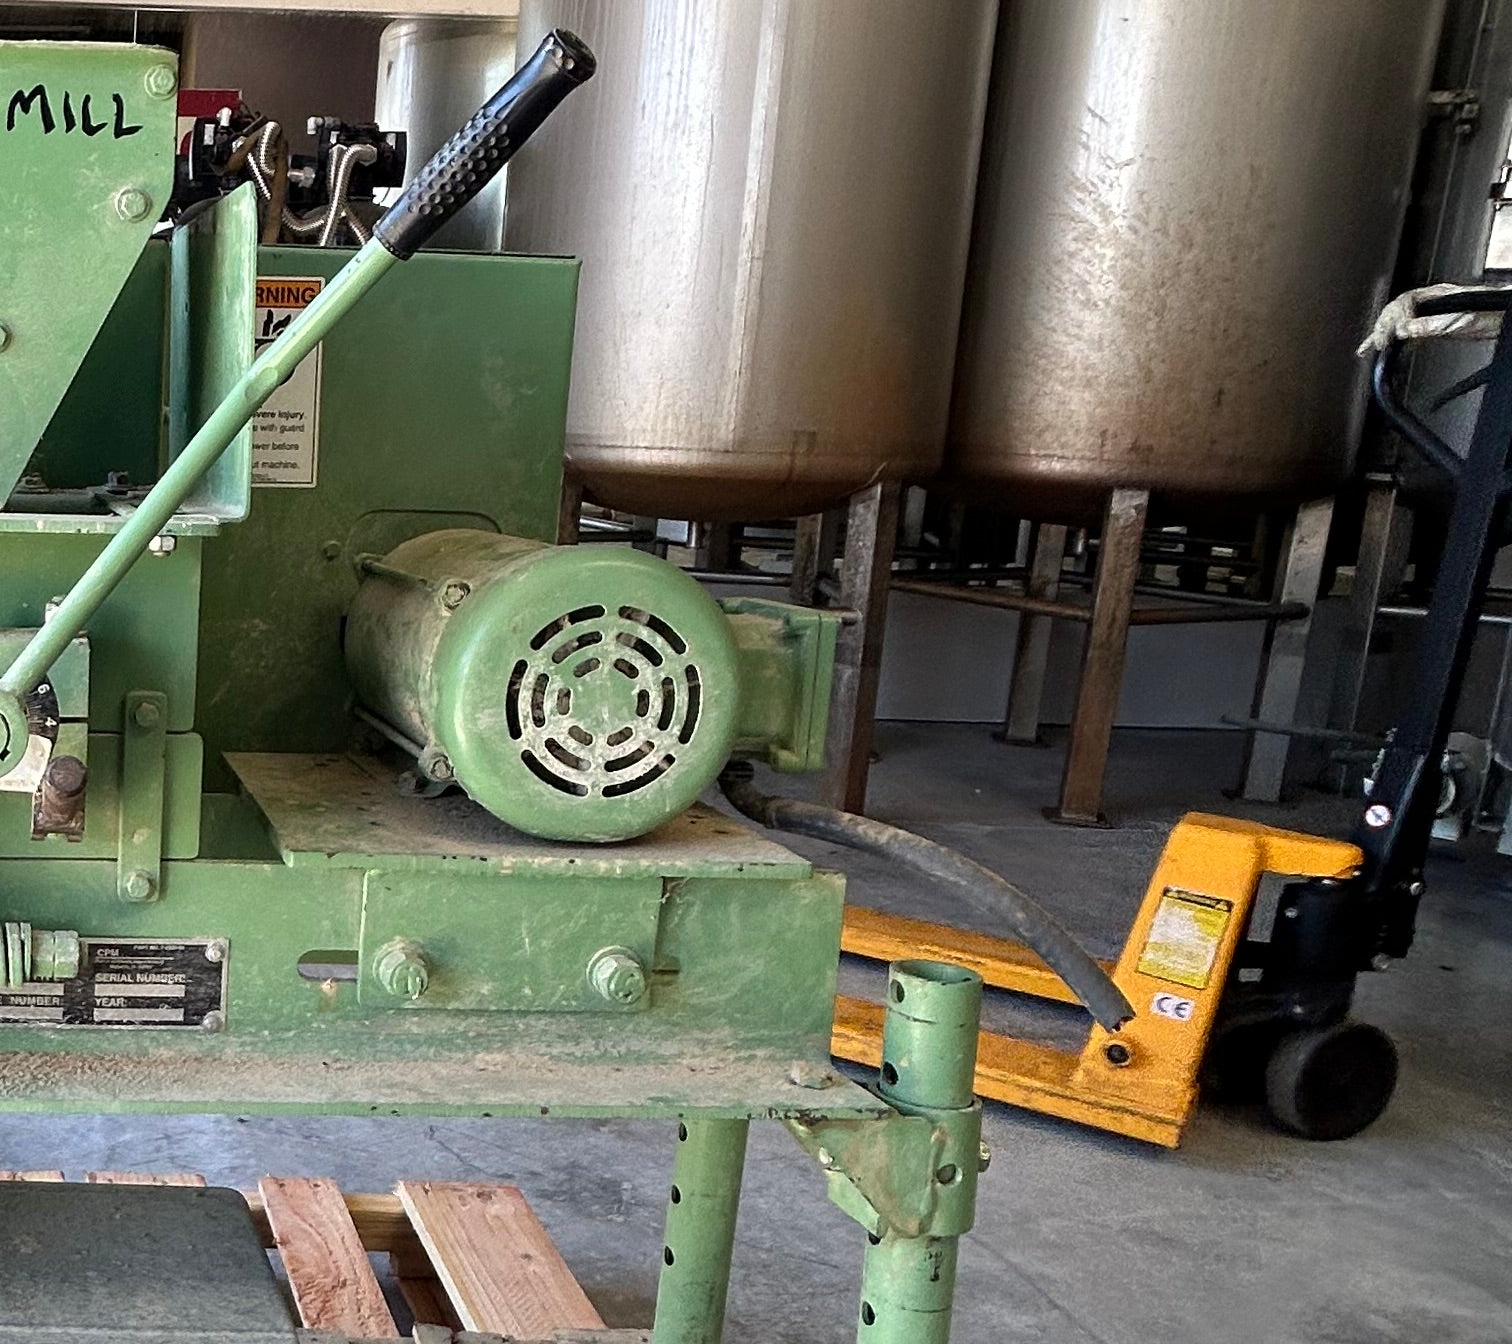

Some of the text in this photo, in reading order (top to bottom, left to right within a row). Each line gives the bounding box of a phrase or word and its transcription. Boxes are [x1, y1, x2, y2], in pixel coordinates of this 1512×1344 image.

[256, 287, 315, 304] RNING
[260, 424, 277, 432] with
[280, 424, 305, 434] guard
[272, 442, 299, 450] before
[45, 716, 57, 727] 4
[96, 948, 120, 956] CPM
[95, 972, 134, 983] SERIAL
[95, 997, 127, 1007] YEAR:
[1155, 996, 1190, 1018] CE
